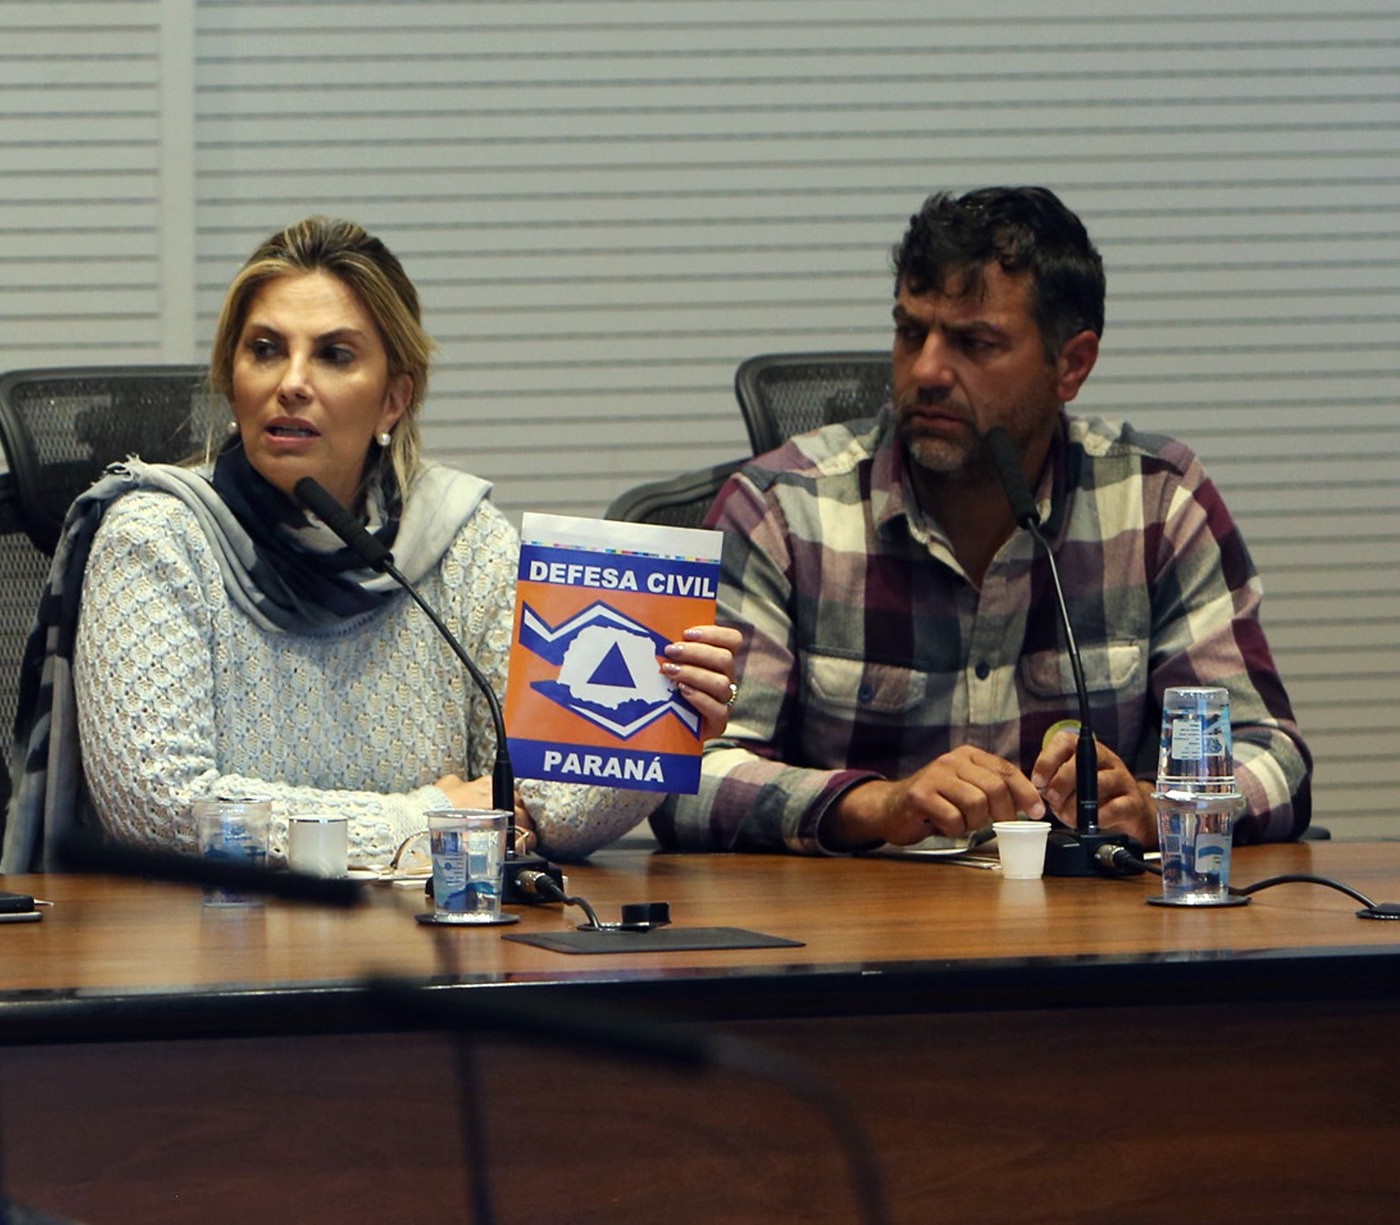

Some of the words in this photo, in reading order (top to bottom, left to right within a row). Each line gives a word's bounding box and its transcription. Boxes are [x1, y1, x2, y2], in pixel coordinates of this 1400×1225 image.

[528, 560, 639, 591] DEFESA
[646, 572, 716, 599] CIVIL
[542, 750, 665, 784] PARANÁ
